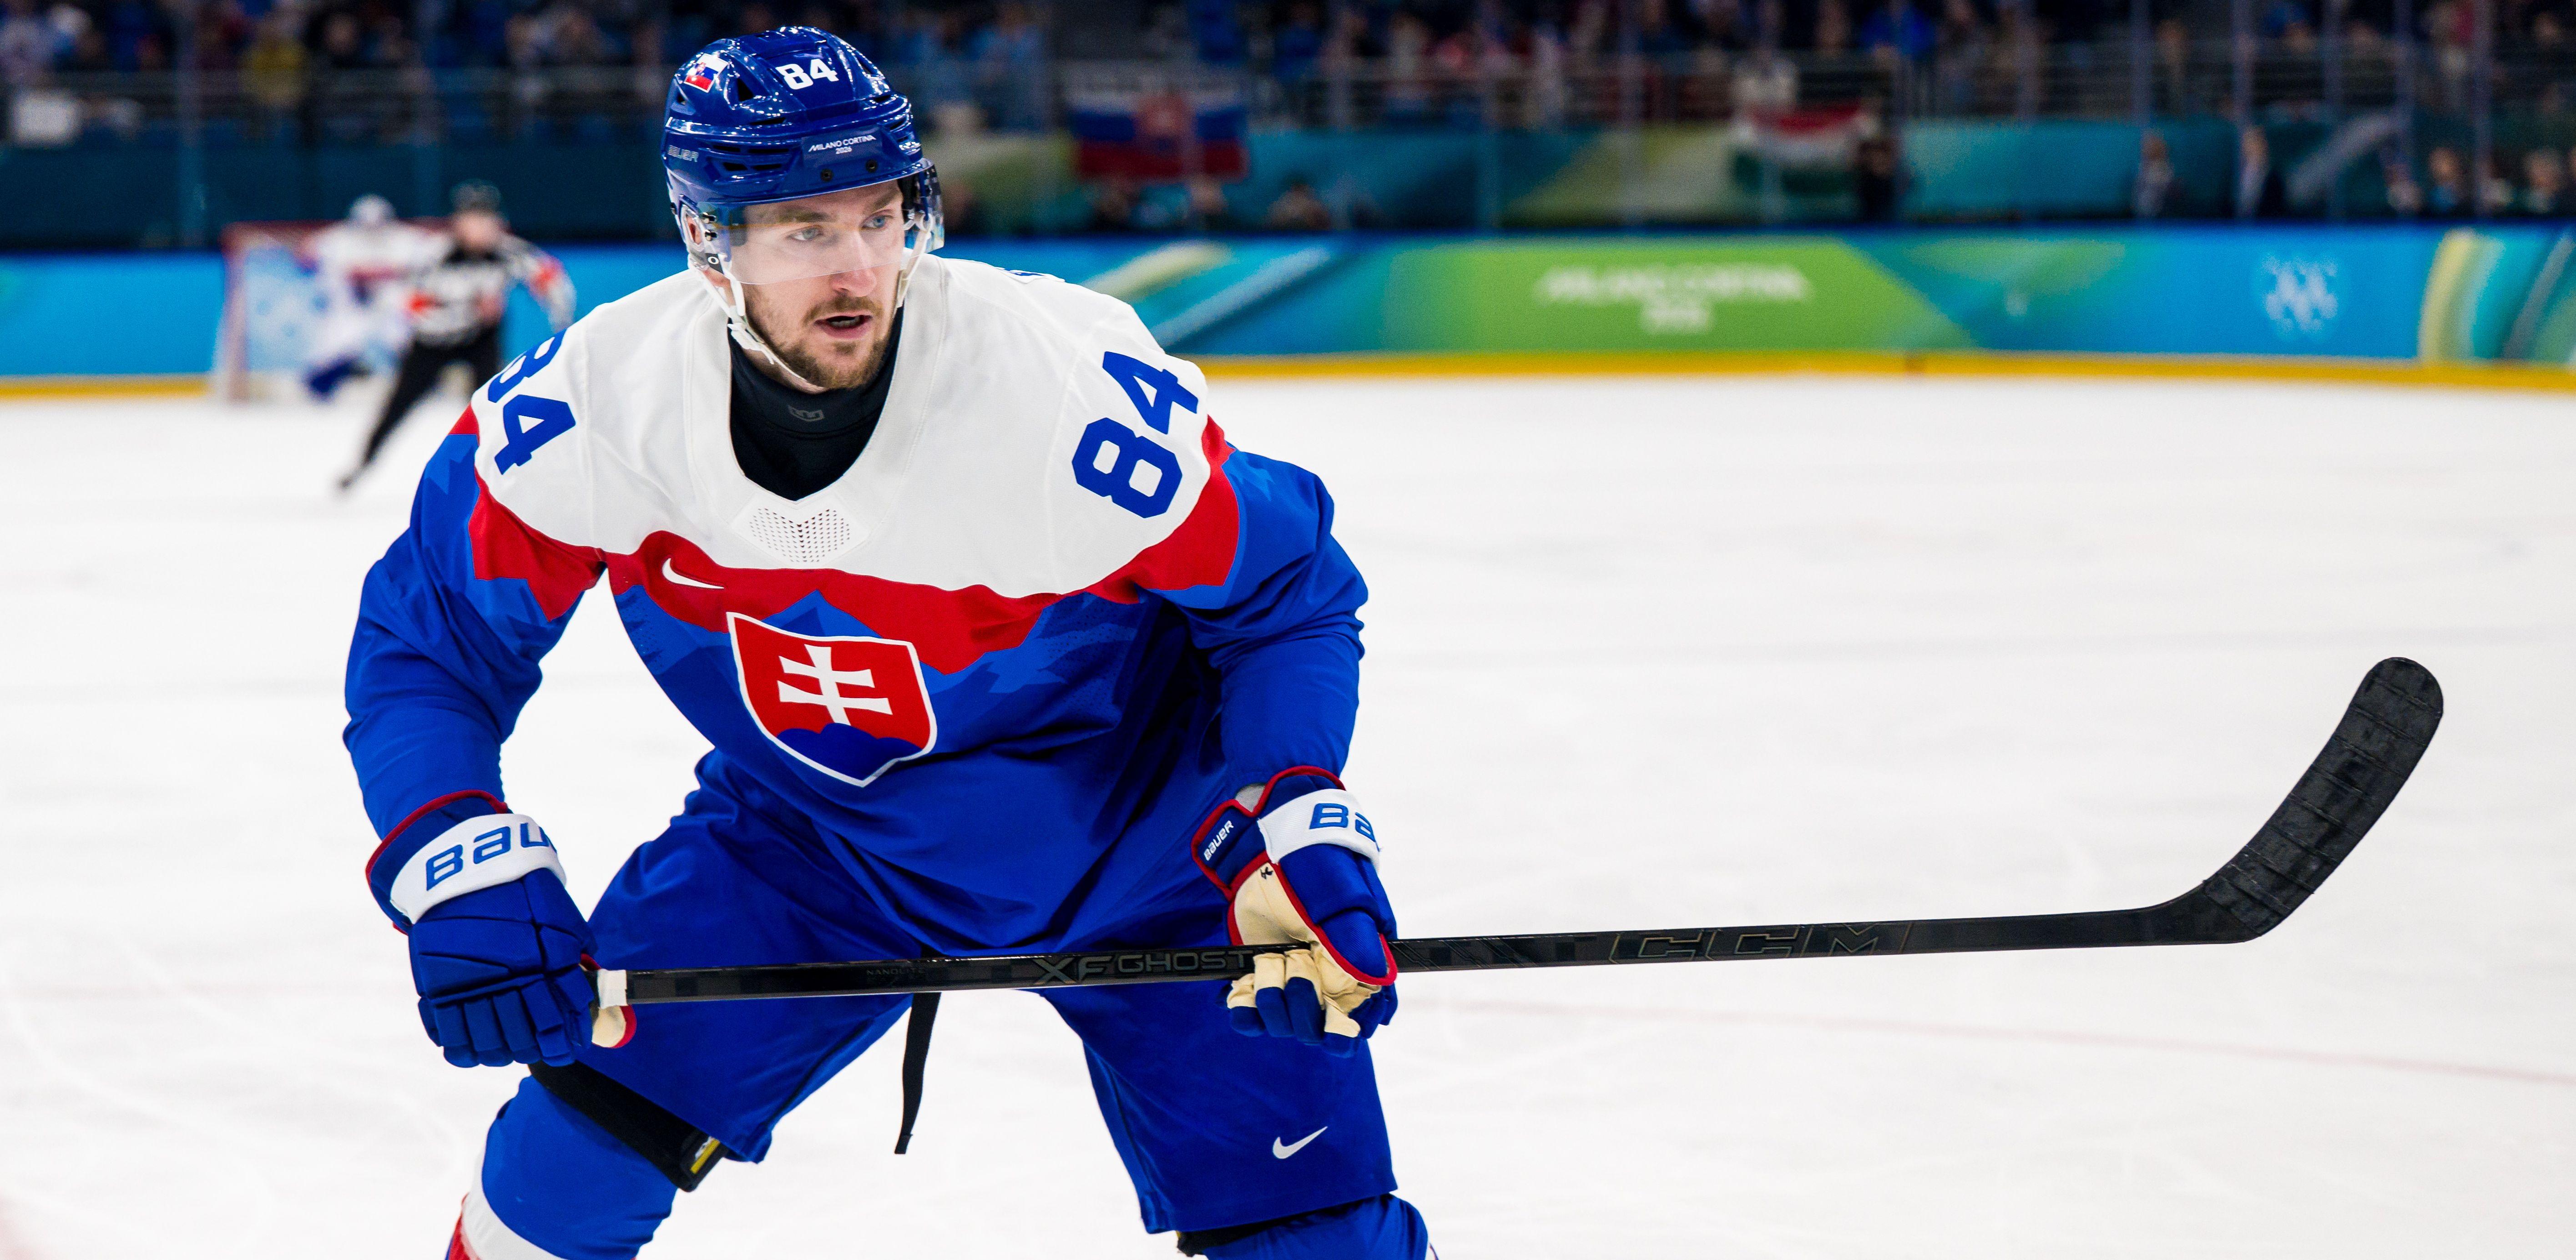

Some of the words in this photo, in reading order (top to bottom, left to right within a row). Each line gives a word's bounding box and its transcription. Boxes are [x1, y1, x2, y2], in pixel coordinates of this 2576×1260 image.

[775, 59, 839, 90] 84
[808, 140, 842, 152] MILANO
[843, 135, 877, 146] CORTINA
[488, 328, 576, 475] 84
[1072, 351, 1198, 519] 84
[1608, 922, 1913, 964] CCM
[1118, 950, 1254, 973] GHOST
